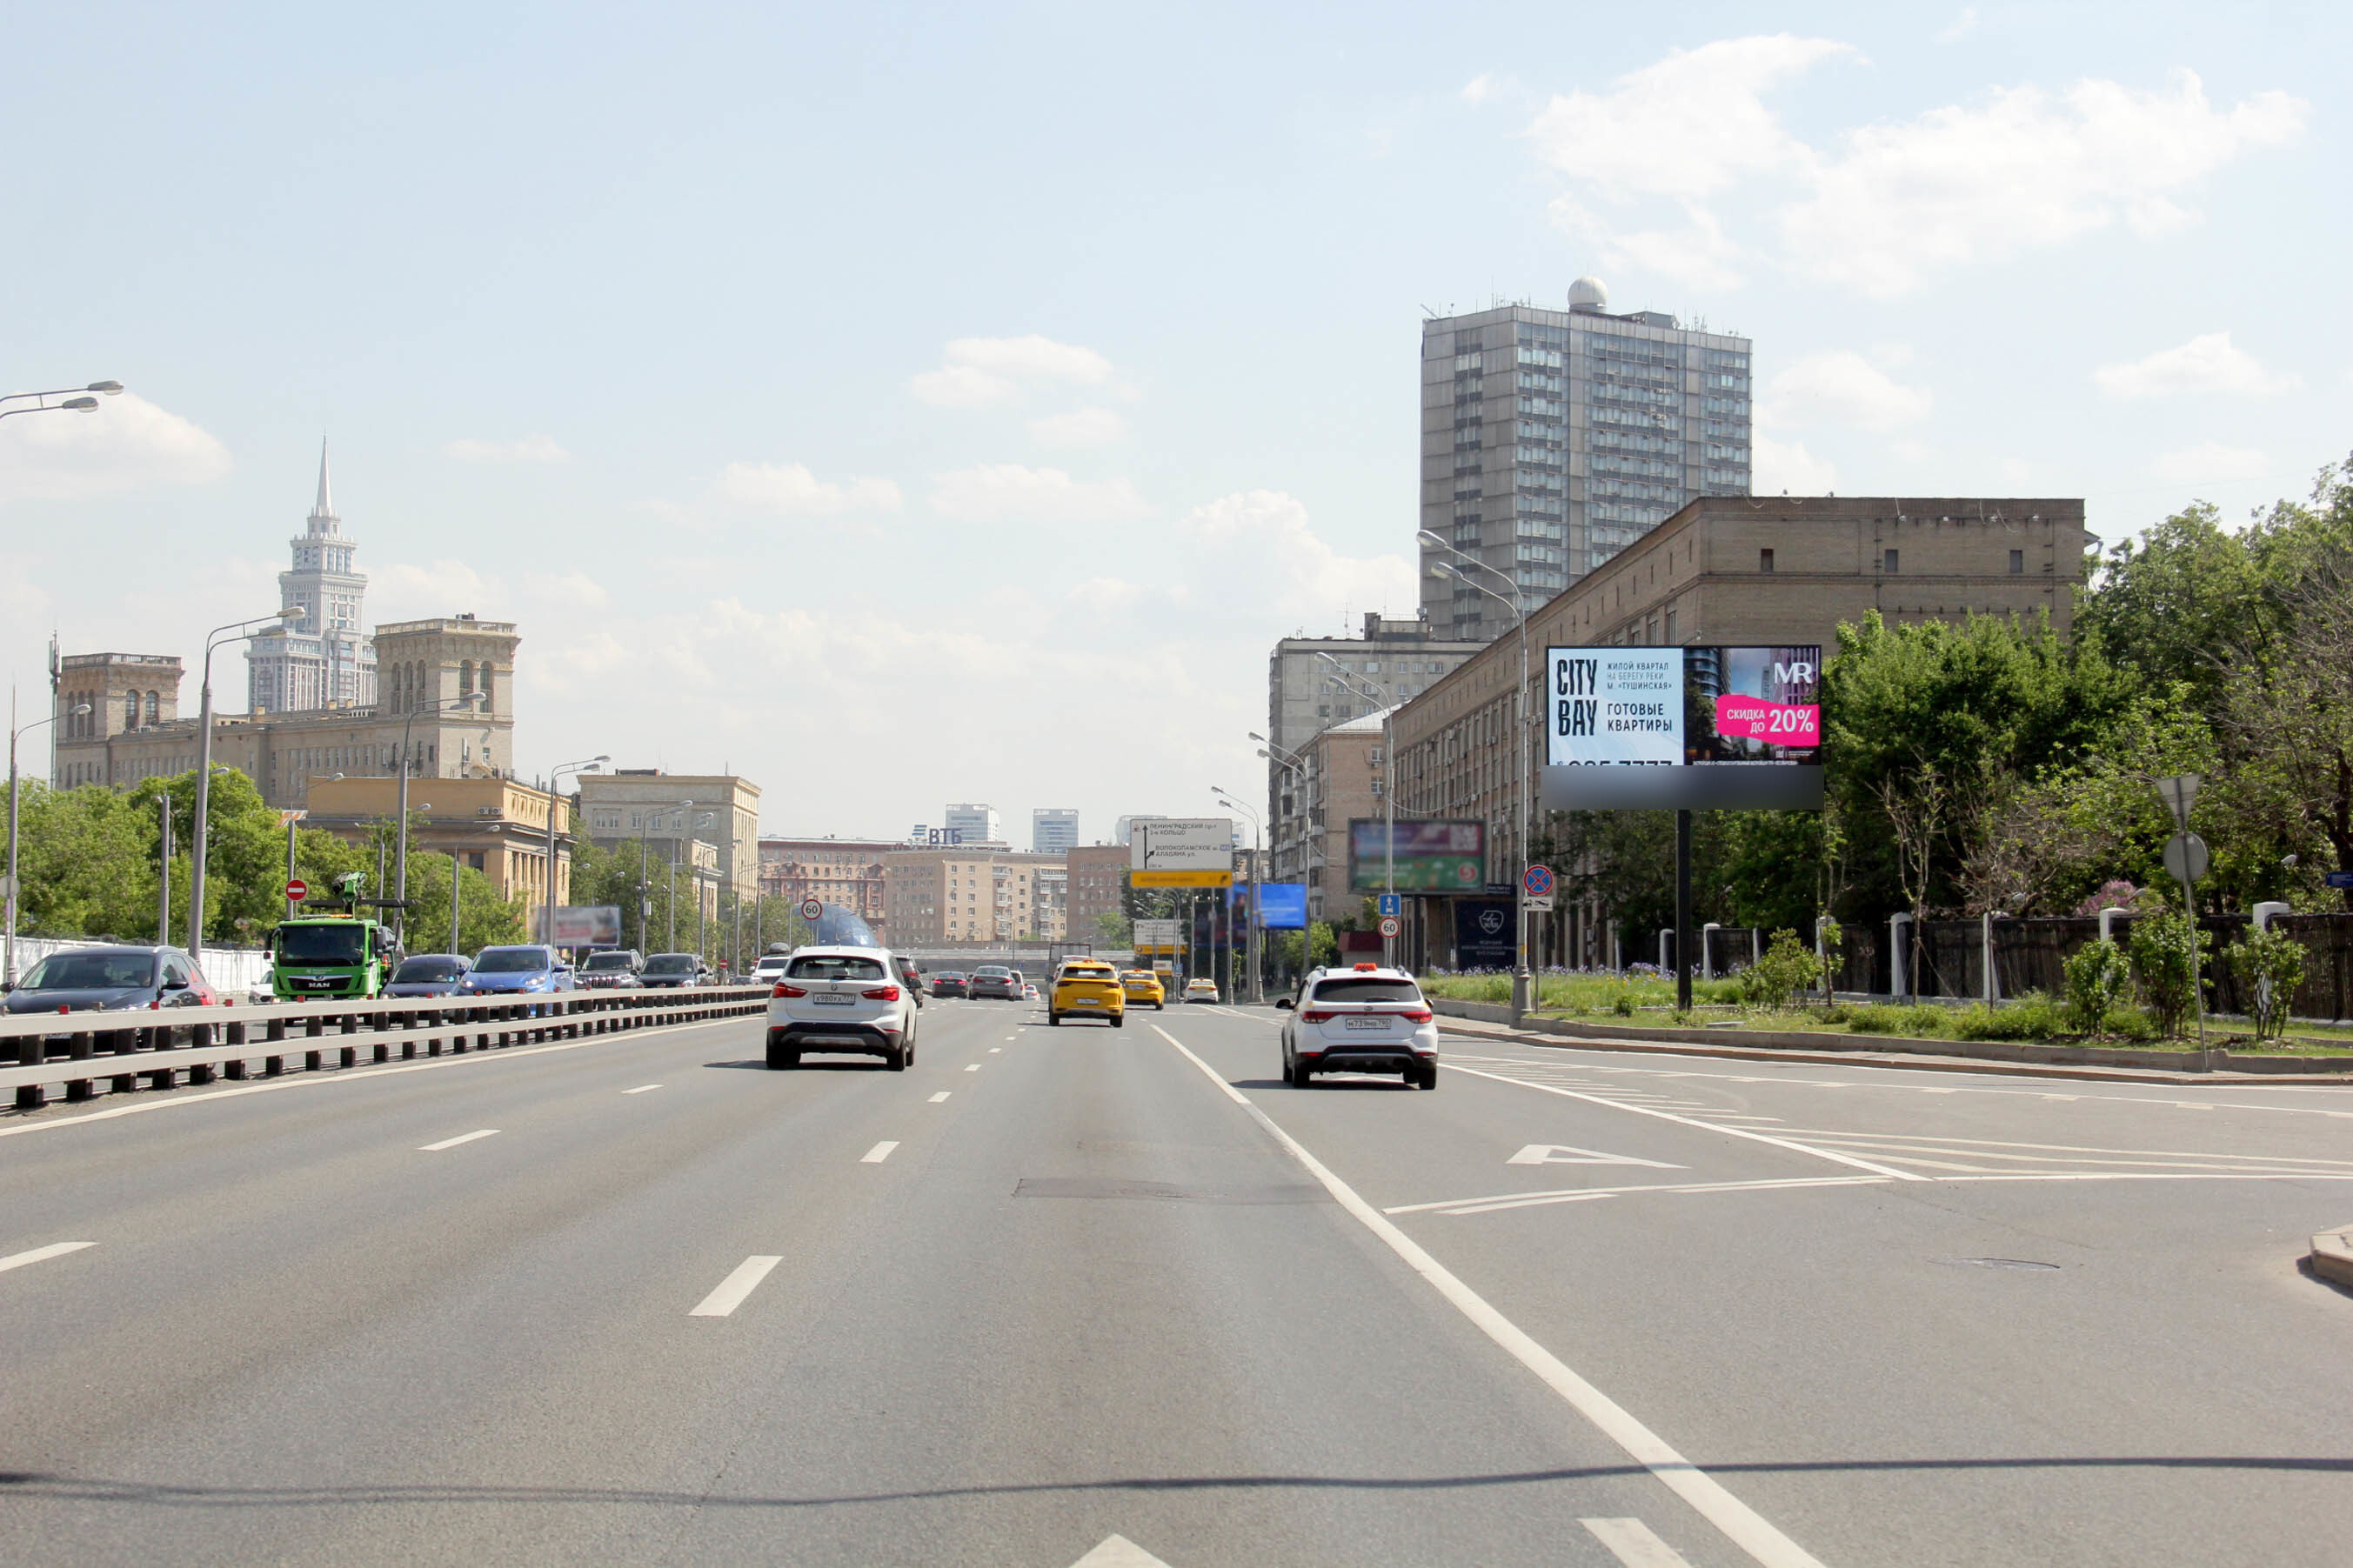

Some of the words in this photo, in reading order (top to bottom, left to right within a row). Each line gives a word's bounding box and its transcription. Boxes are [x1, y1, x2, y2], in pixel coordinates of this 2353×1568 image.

[1608, 661, 1634, 671] ЖИЛОЙ
[1636, 662, 1668, 671] КВАРТАЛ
[1557, 659, 1597, 695] CITY
[1775, 662, 1813, 684] MR
[1608, 703, 1663, 716] ГОТОВЫЕ
[1727, 709, 1766, 721] СКИДКА
[1558, 699, 1597, 736] BAY
[1768, 709, 1815, 732] 20%
[1608, 719, 1672, 731] КВАРТИРЫ
[1750, 722, 1765, 734] ДО
[929, 828, 961, 844] ВТБ
[806, 904, 818, 914] 60
[1383, 923, 1396, 932] 60
